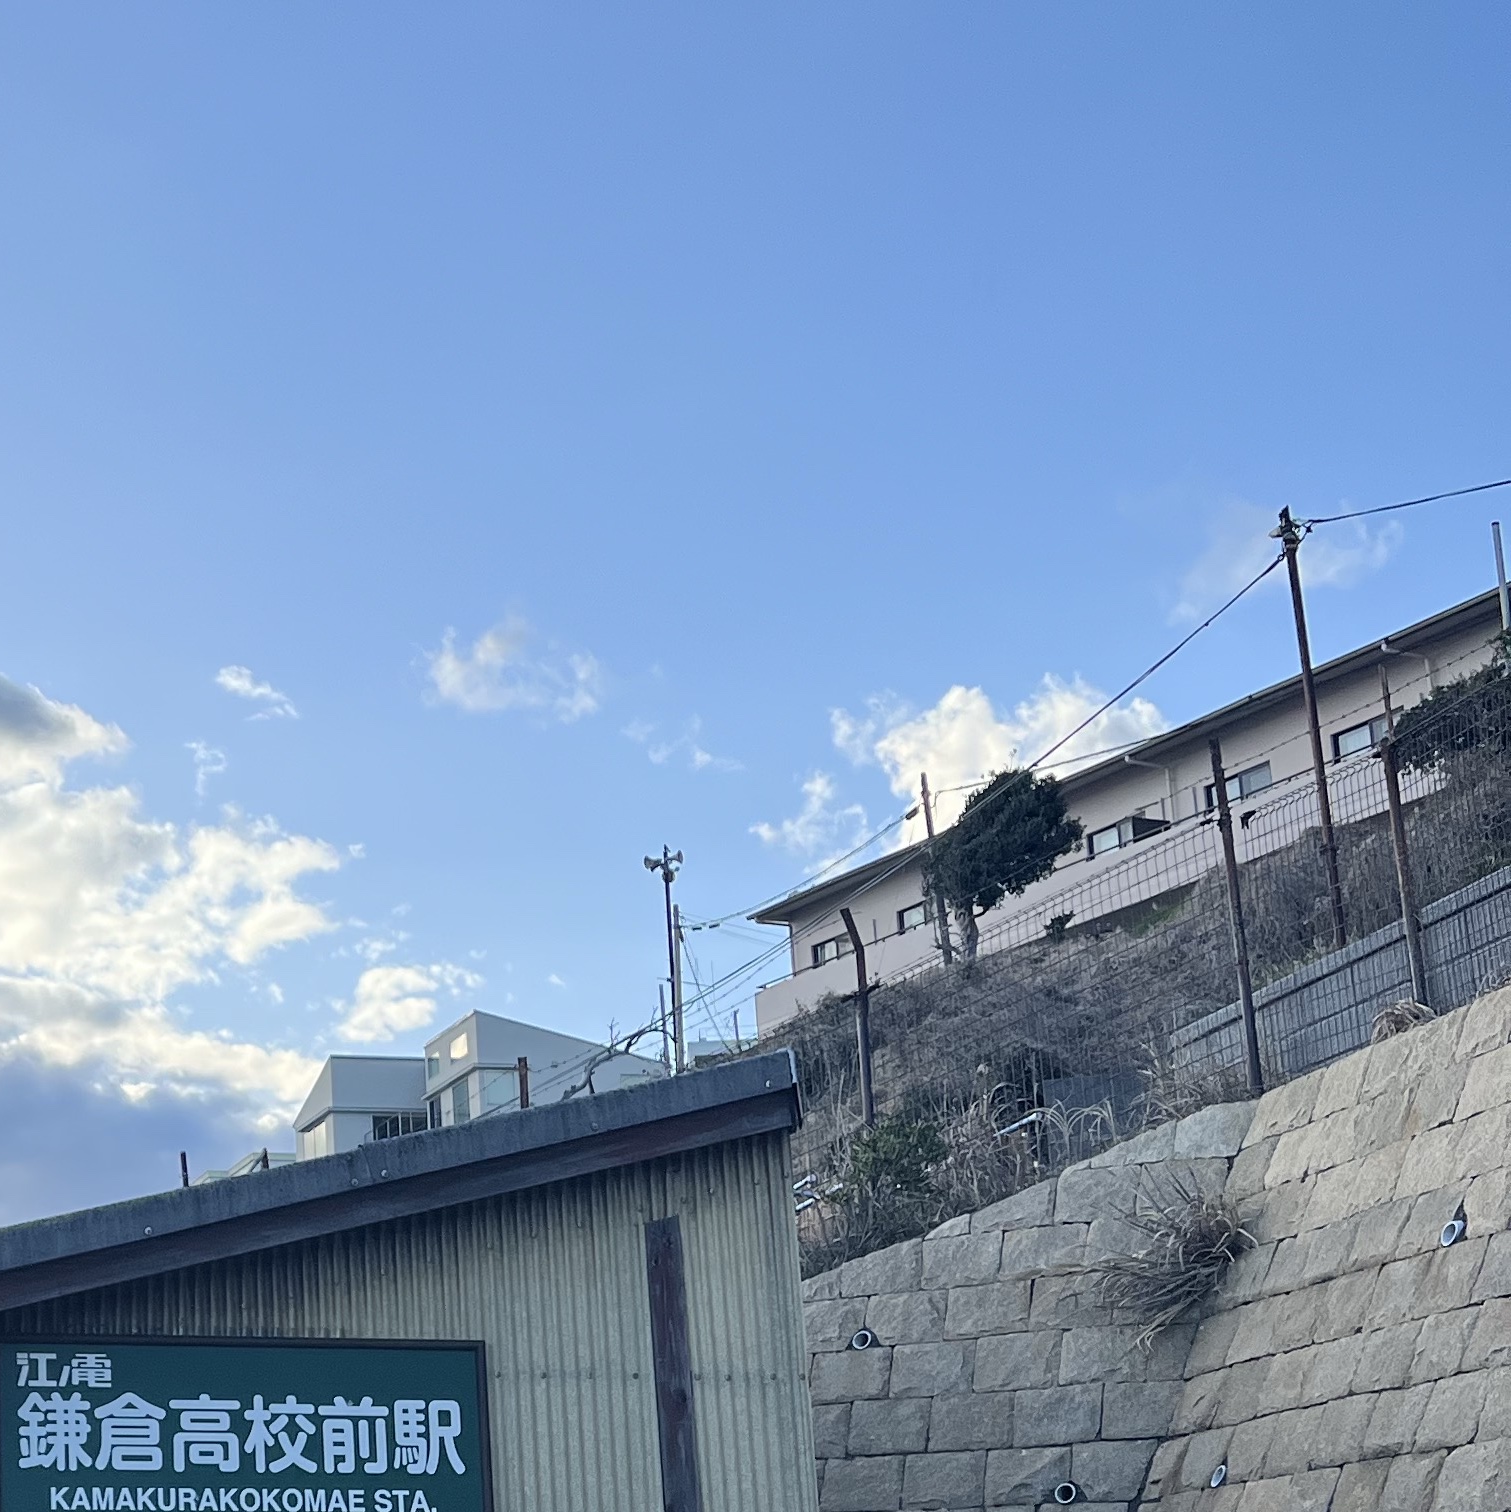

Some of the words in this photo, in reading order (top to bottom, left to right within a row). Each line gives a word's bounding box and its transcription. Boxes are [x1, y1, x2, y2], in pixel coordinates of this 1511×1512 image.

[16, 1352, 112, 1388] 江ノ電
[16, 1391, 466, 1475] 鎌倉高校前駅
[50, 1486, 366, 1512] KAMAKURAKOKOMAE
[373, 1490, 438, 1512] STA.
